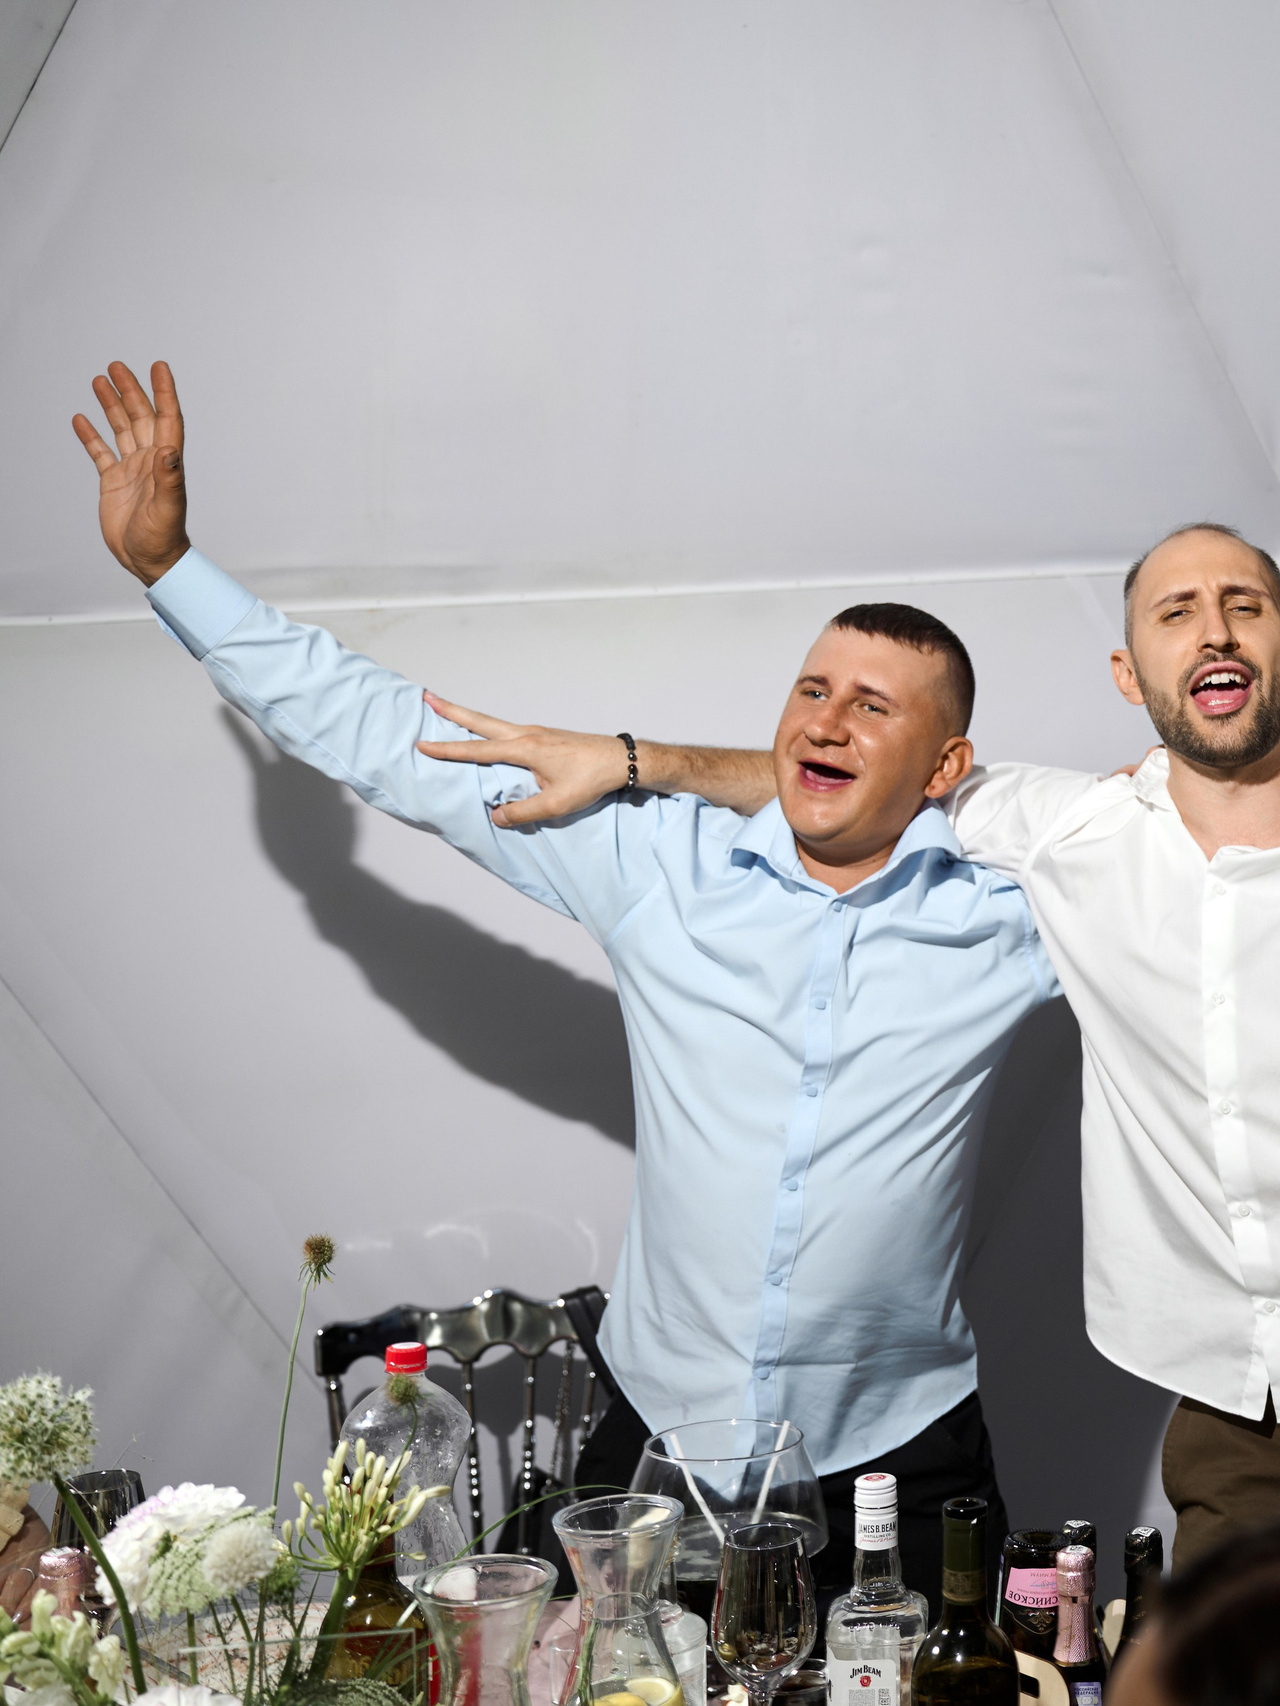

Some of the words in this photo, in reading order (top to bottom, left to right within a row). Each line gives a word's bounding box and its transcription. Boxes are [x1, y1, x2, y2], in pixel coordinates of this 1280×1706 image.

[1008, 1590, 1059, 1608] СИЙСКОЕ
[850, 1667, 863, 1678] JIM
[863, 1664, 882, 1678] BEAM
